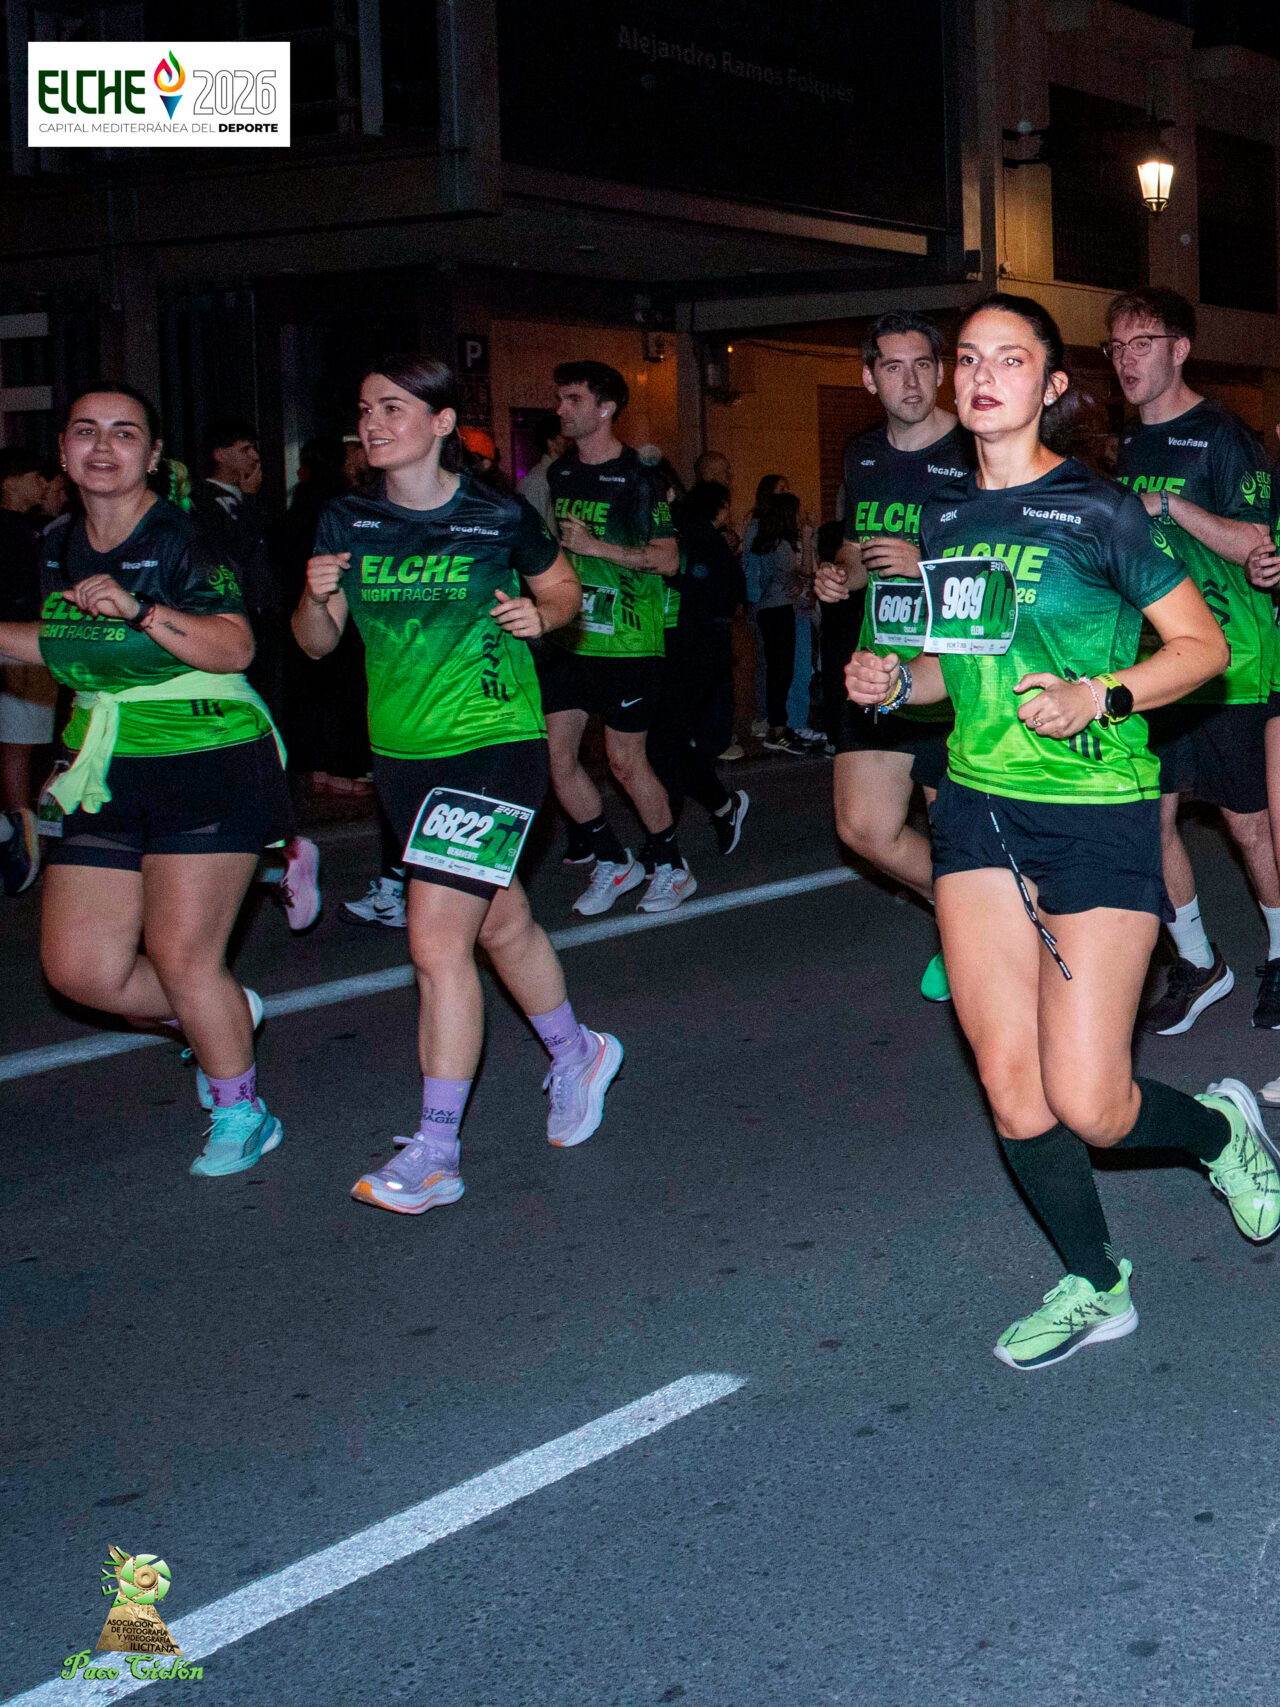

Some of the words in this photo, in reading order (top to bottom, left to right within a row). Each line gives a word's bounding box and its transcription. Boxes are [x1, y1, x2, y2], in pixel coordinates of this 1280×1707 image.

[617, 24, 716, 70] Alejandro
[465, 340, 482, 368] P
[352, 520, 380, 530] 42K
[362, 556, 475, 584] ELCHE
[445, 587, 467, 601] '26
[942, 577, 986, 620] 989
[878, 595, 923, 624] 6061
[102, 627, 126, 641] '26
[422, 803, 495, 849] 6822
